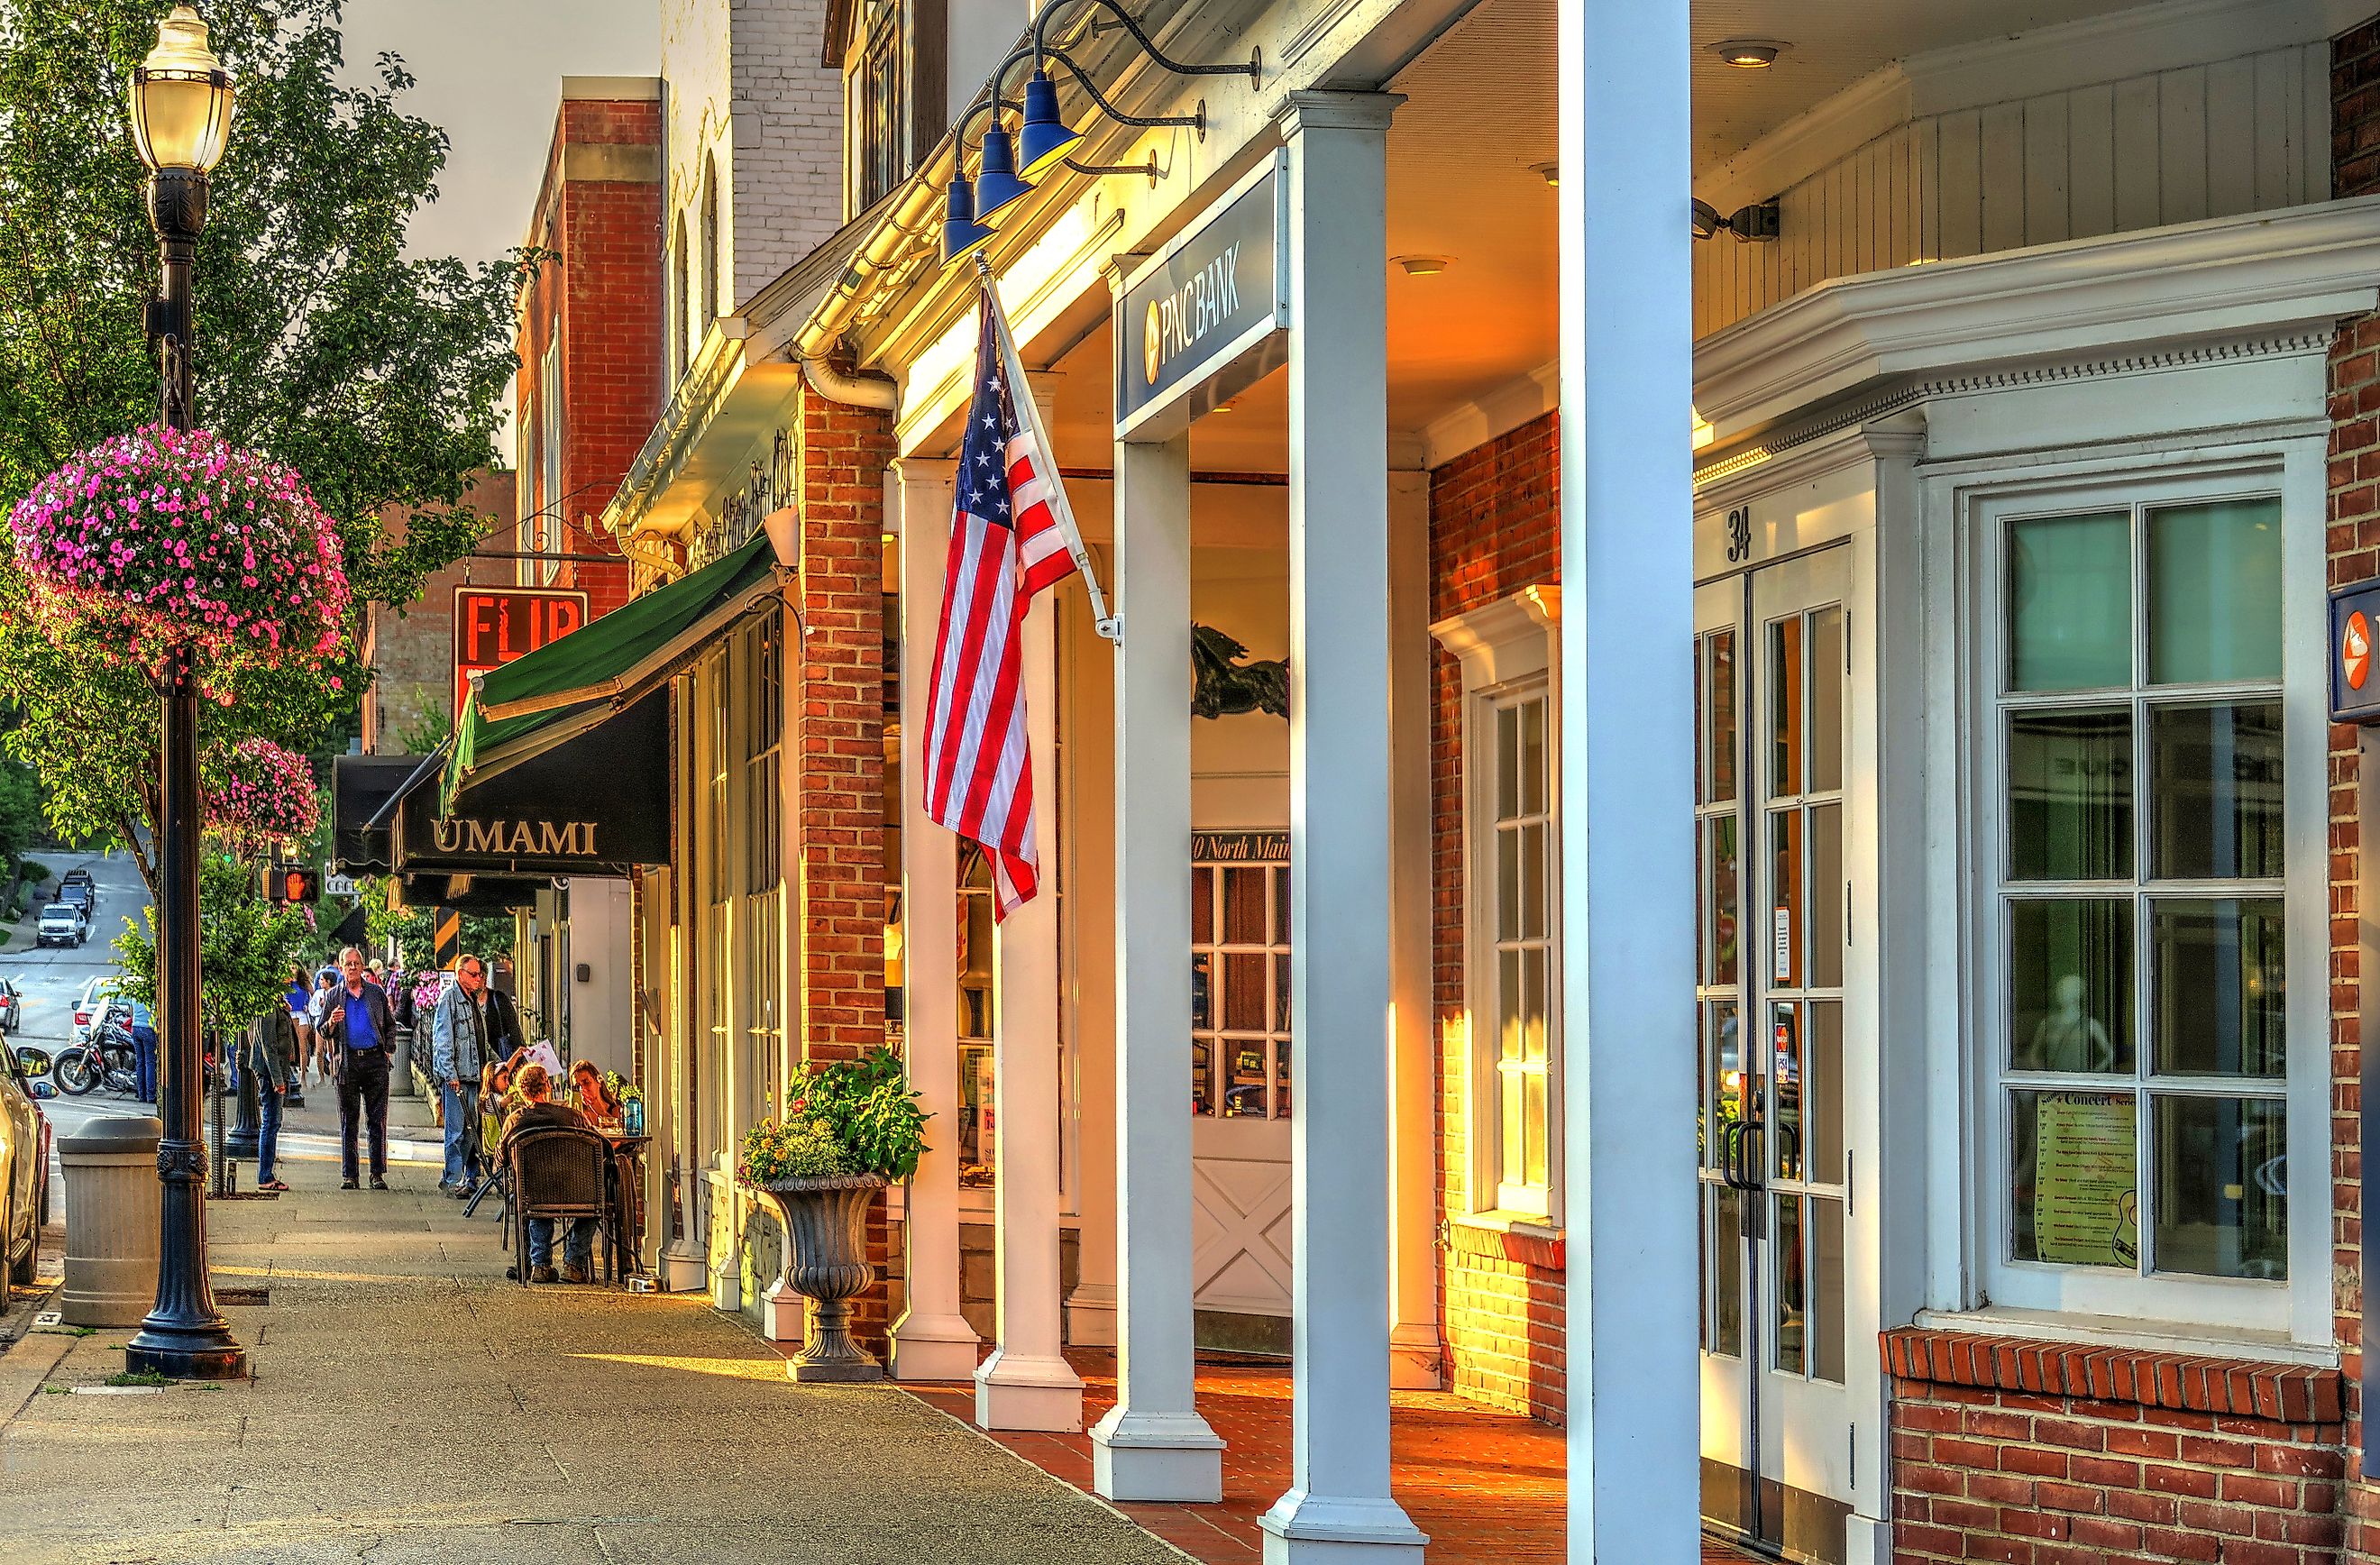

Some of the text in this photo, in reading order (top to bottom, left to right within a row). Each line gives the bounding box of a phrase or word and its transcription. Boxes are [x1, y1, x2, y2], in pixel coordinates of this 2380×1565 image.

[1160, 240, 1240, 365] PNC BANK
[1727, 506, 1751, 563] 34
[467, 596, 580, 663] FLIP
[430, 819, 598, 856] UMAMI
[1206, 835, 1249, 860] North
[2064, 1093, 2112, 1106] Concert
